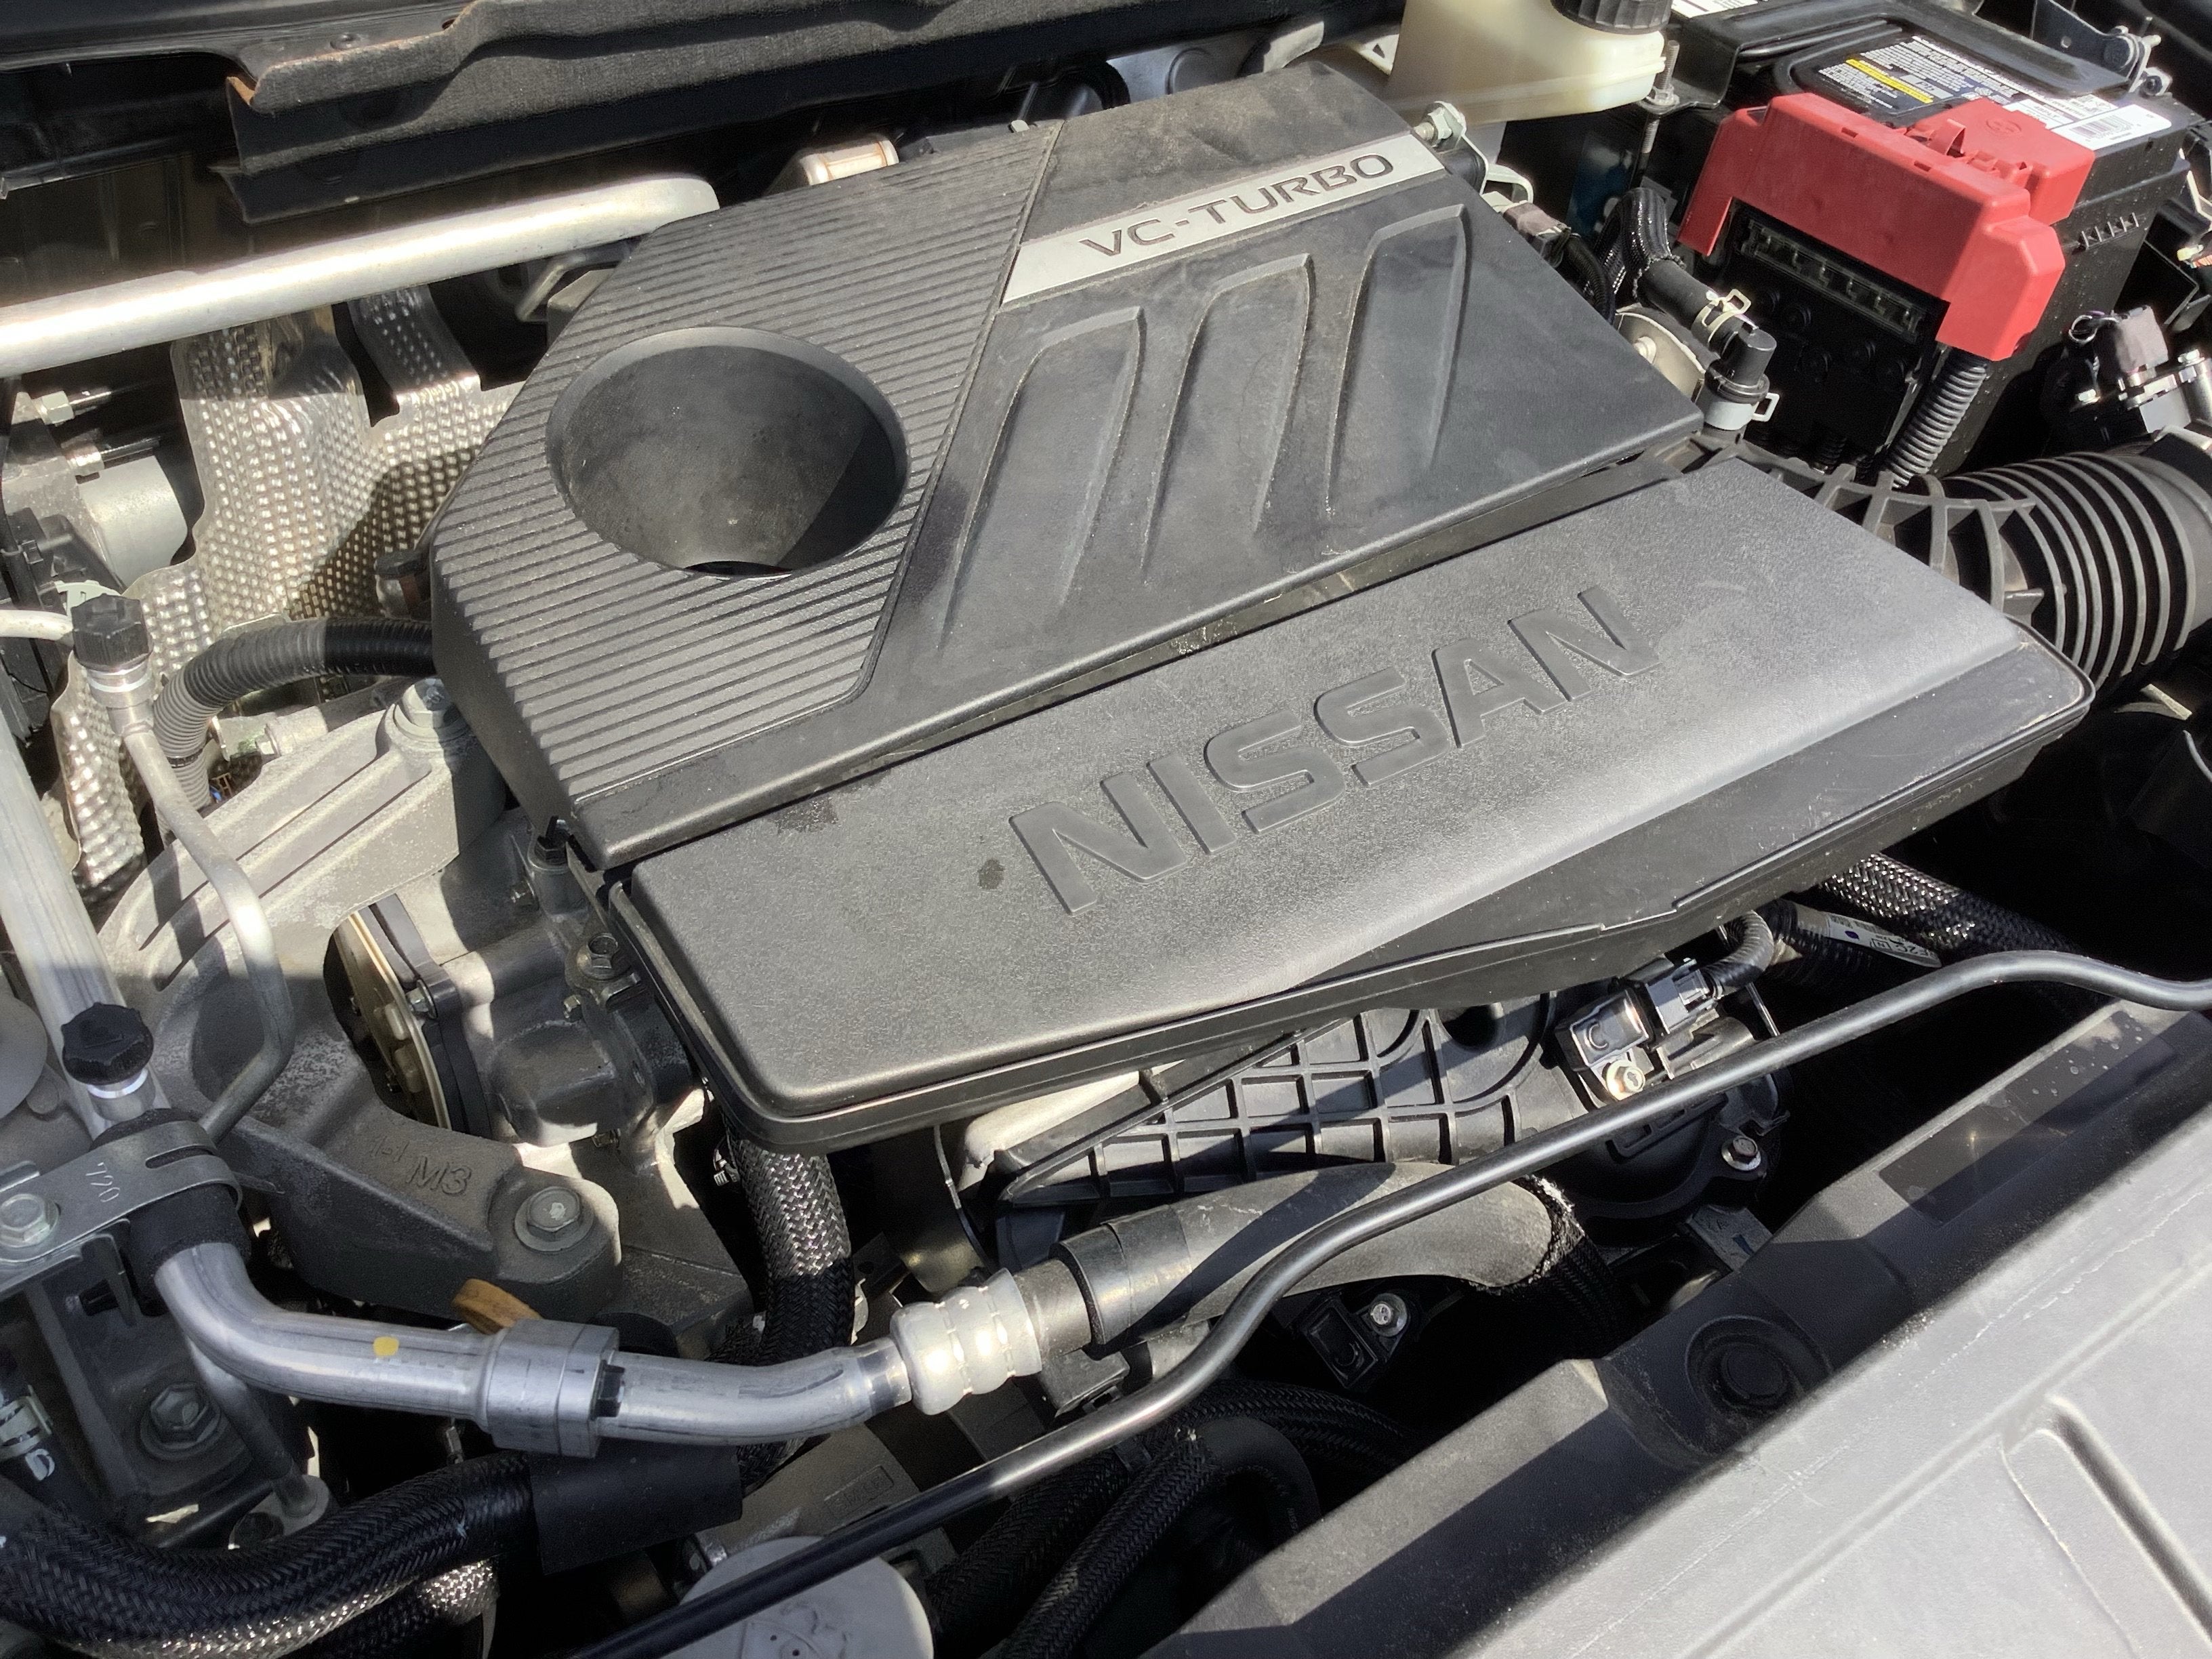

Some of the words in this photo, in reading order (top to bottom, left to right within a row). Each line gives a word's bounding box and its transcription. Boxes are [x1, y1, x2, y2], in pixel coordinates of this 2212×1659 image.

[1079, 153, 1394, 257] VC-TURBO
[1008, 586, 1662, 915] NISSAN
[406, 1157, 472, 1197] M3
